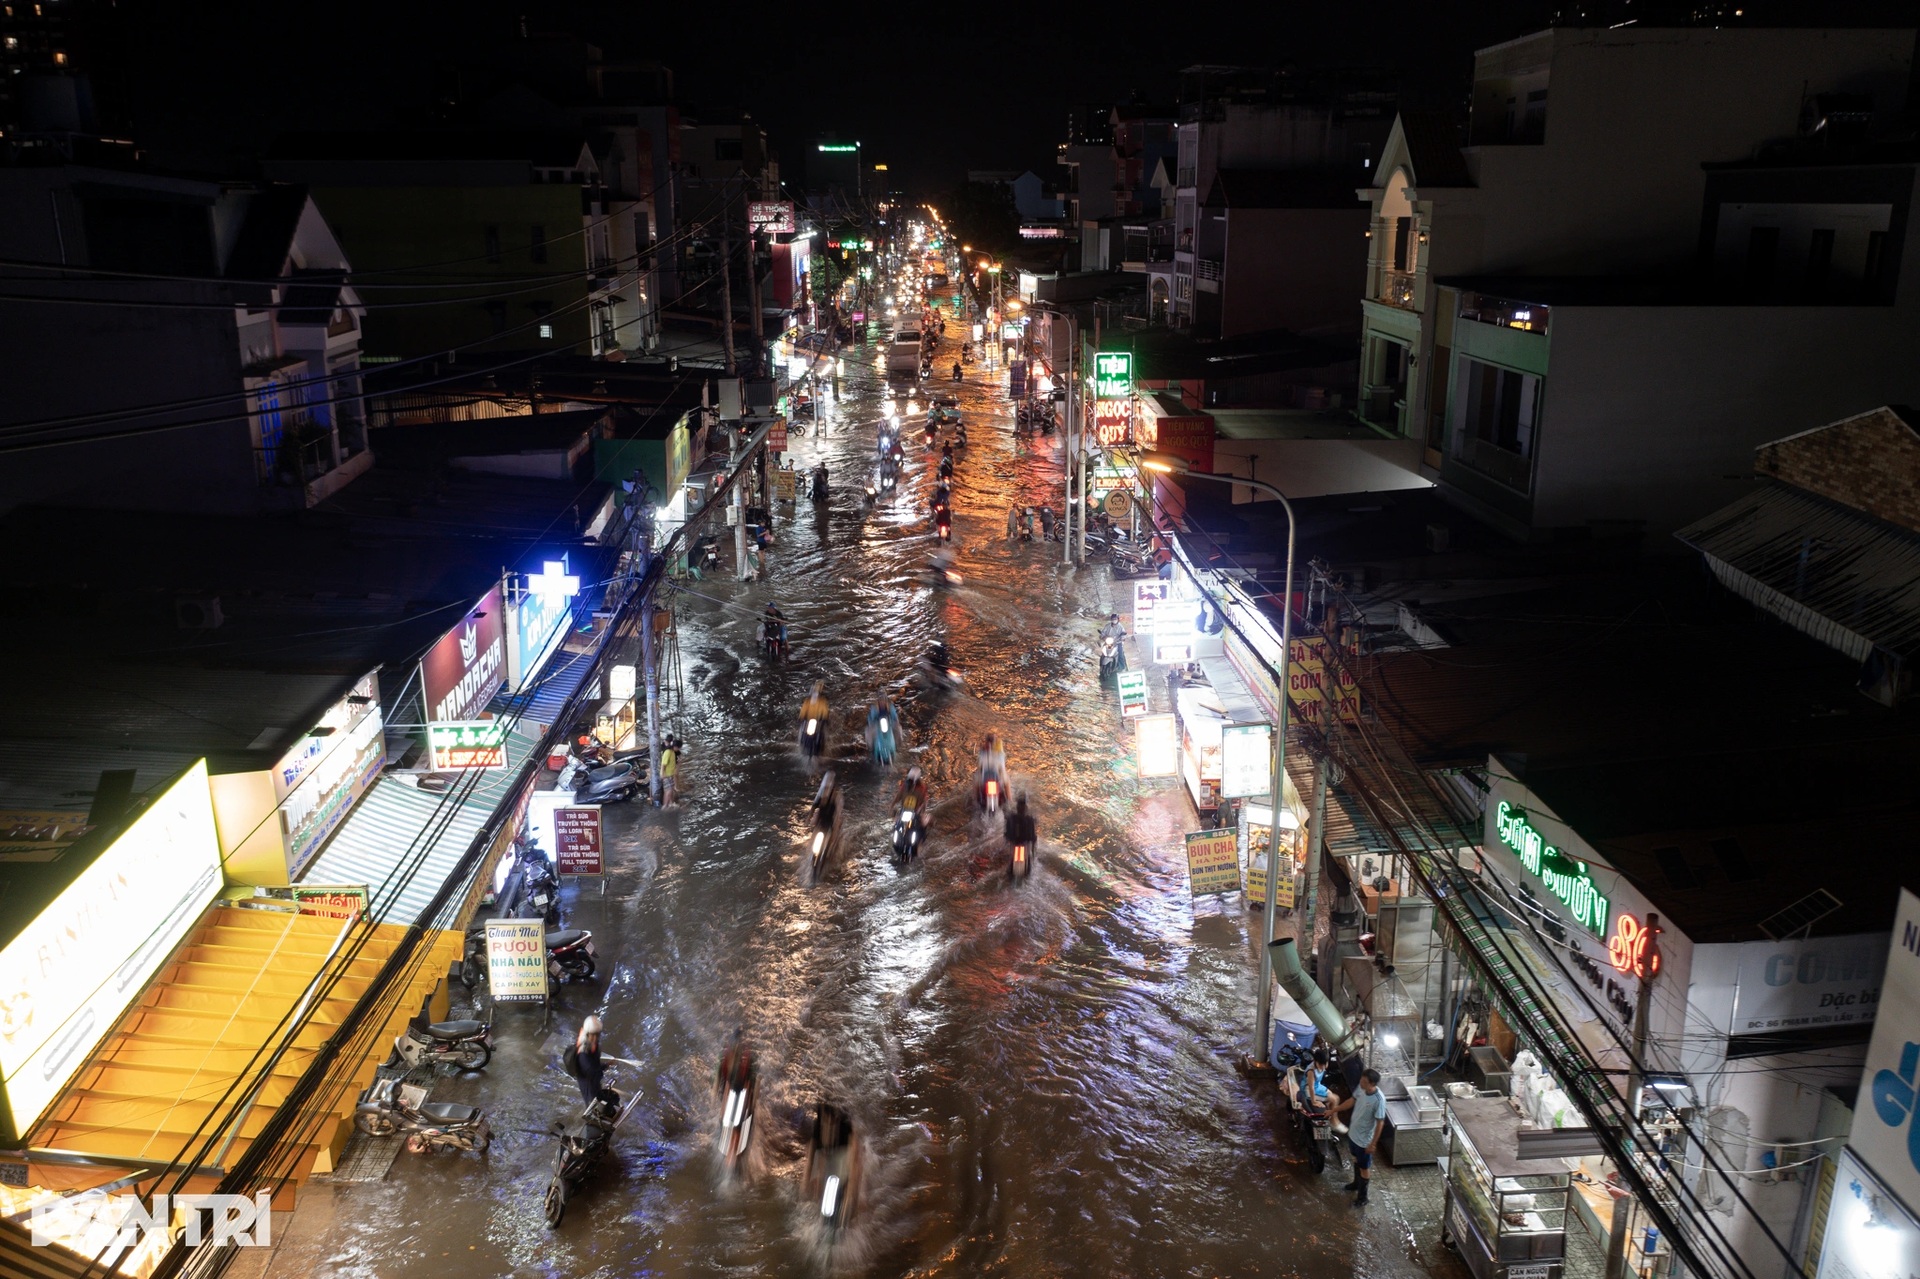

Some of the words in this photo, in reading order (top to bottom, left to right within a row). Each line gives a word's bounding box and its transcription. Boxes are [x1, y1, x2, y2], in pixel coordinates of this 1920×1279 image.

[1096, 400, 1130, 420] NGỌC
[1100, 421, 1126, 445] QUÝ
[1164, 436, 1188, 448] NGỌC
[436, 637, 502, 721] MANDACHA
[1212, 830, 1231, 838] 88A
[1190, 842, 1211, 858] BÚN
[1213, 836, 1234, 854] CHẢ
[1192, 866, 1204, 875] BÚN
[1205, 865, 1216, 874] THỊT
[1217, 862, 1236, 872] NƯỚNG
[488, 926, 517, 938] Thanh
[519, 926, 540, 938] Mai
[492, 940, 538, 955] RƯỢU
[491, 955, 515, 967] NHÀ
[518, 954, 541, 967] NẤU
[508, 980, 524, 988] PHÊ
[1818, 992, 1856, 1009] Đặc
[1782, 1017, 1809, 1026] PHẠM
[1812, 1014, 1831, 1023] HỮU
